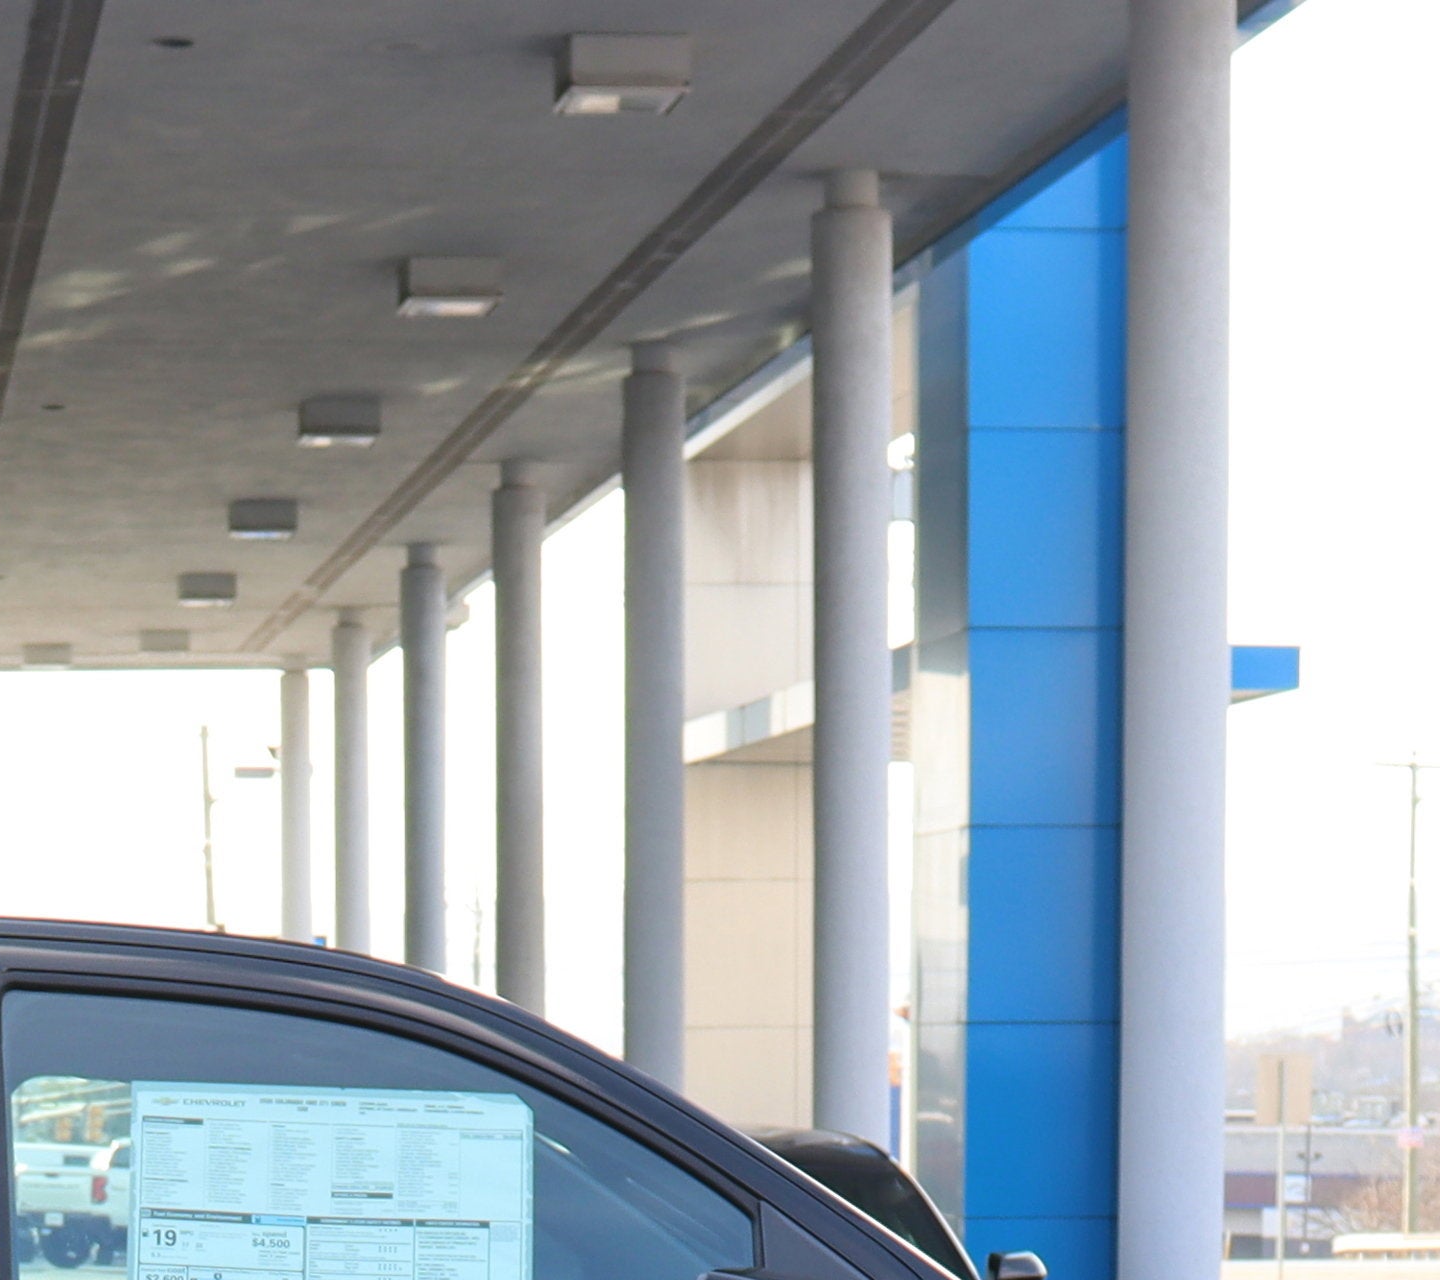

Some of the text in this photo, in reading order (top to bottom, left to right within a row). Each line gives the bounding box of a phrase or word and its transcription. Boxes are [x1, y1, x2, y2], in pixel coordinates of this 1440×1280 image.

[183, 1098, 246, 1107] CHEVROLET
[153, 1229, 177, 1246] 19
[252, 1238, 290, 1248] $4,500
